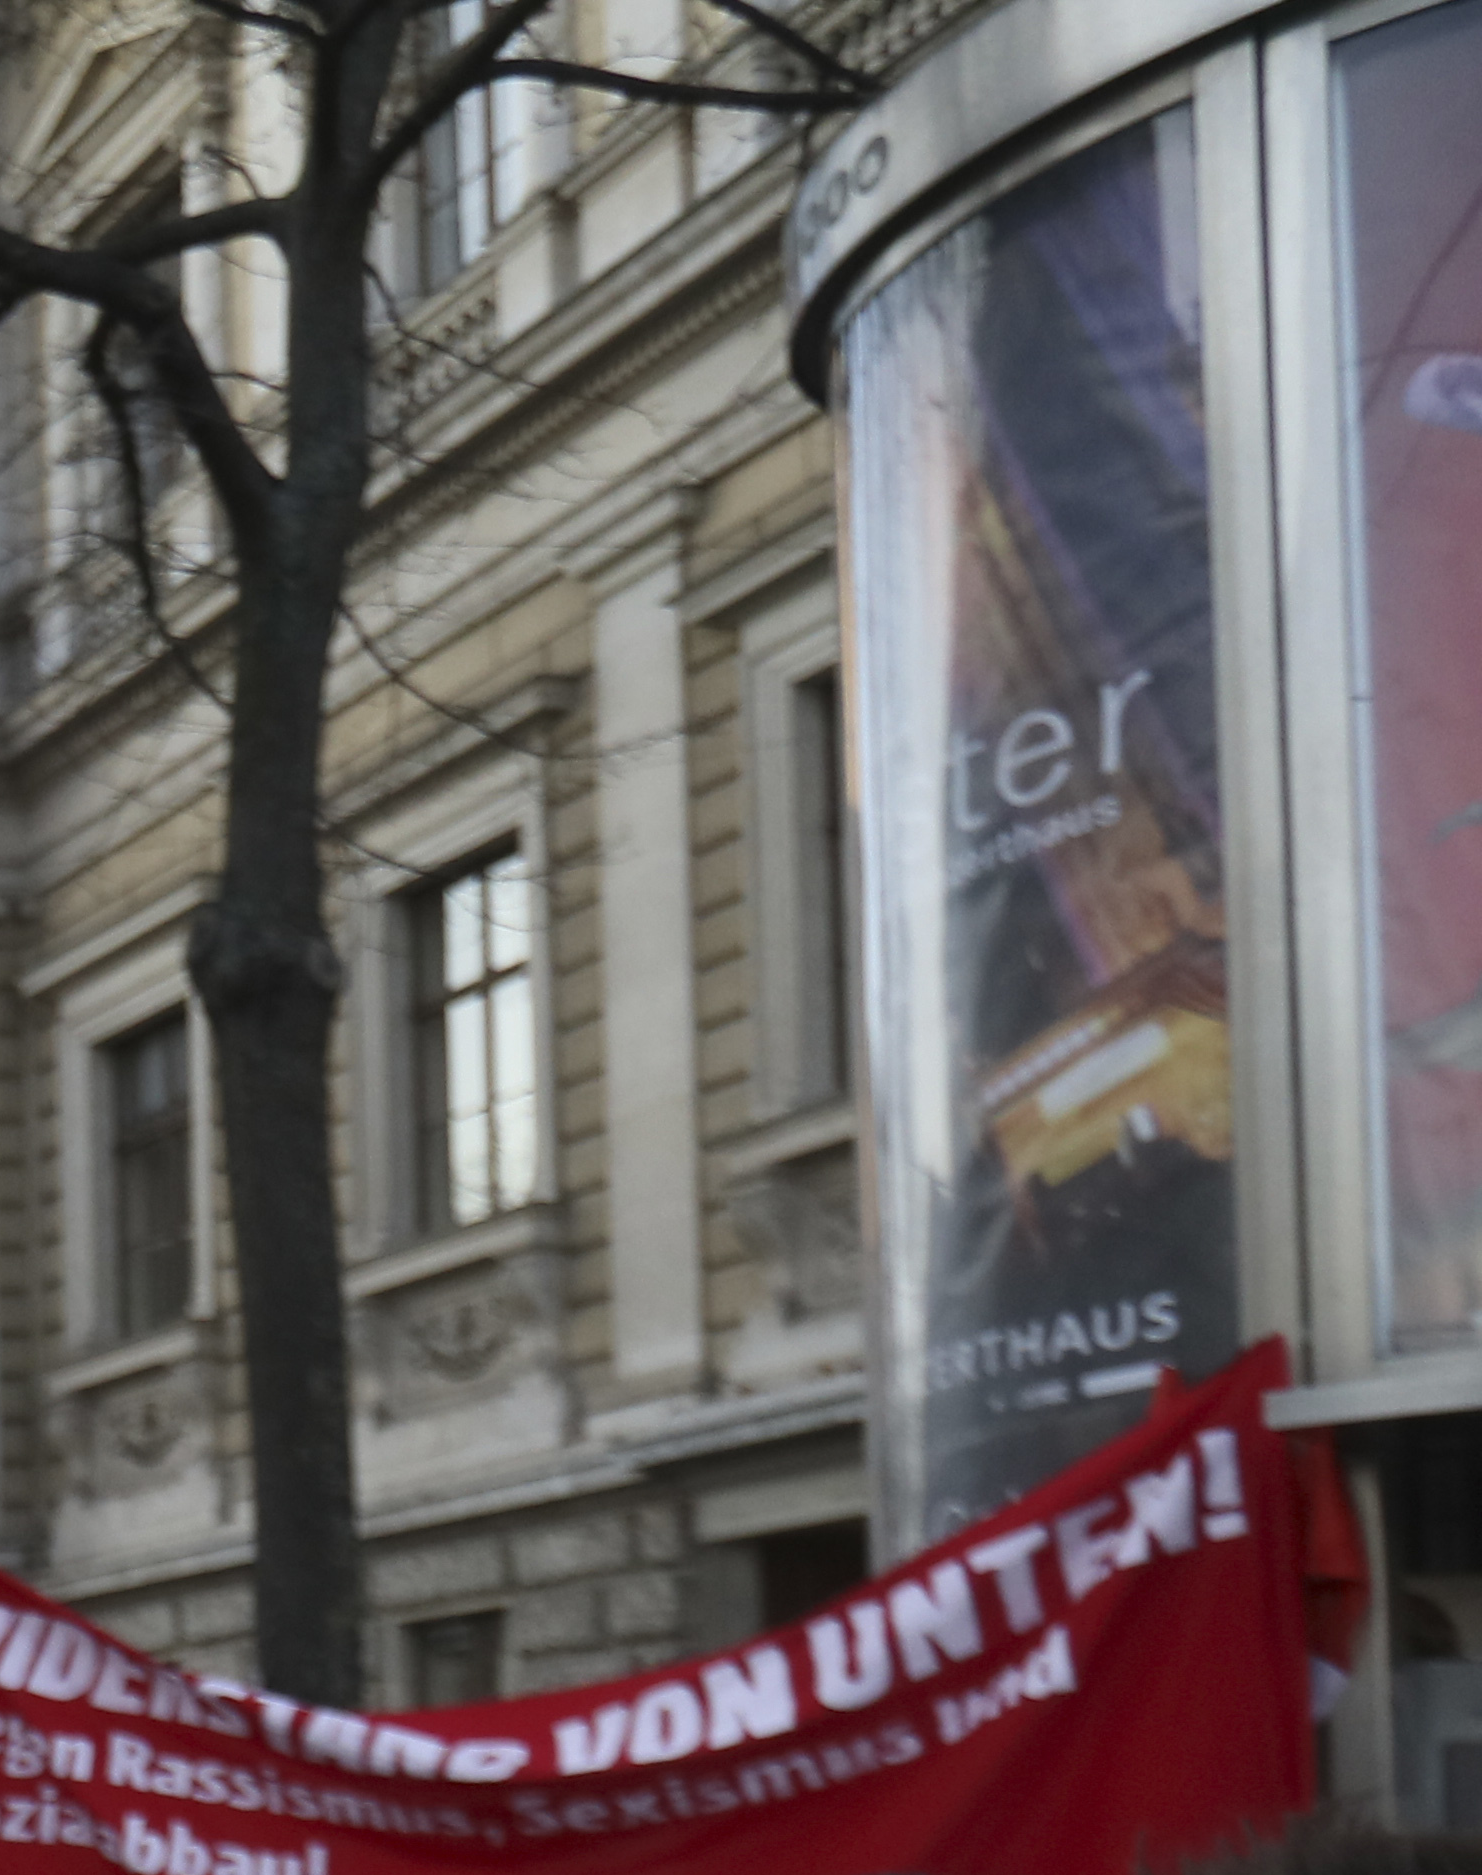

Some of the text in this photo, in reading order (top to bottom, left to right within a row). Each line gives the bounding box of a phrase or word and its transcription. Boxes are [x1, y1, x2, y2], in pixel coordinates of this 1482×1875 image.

[552, 1643, 798, 1777] VON
[805, 1426, 1251, 1712] UNTEN!
[106, 1728, 507, 1849] Rassismus,
[510, 1717, 926, 1839] Sexismus
